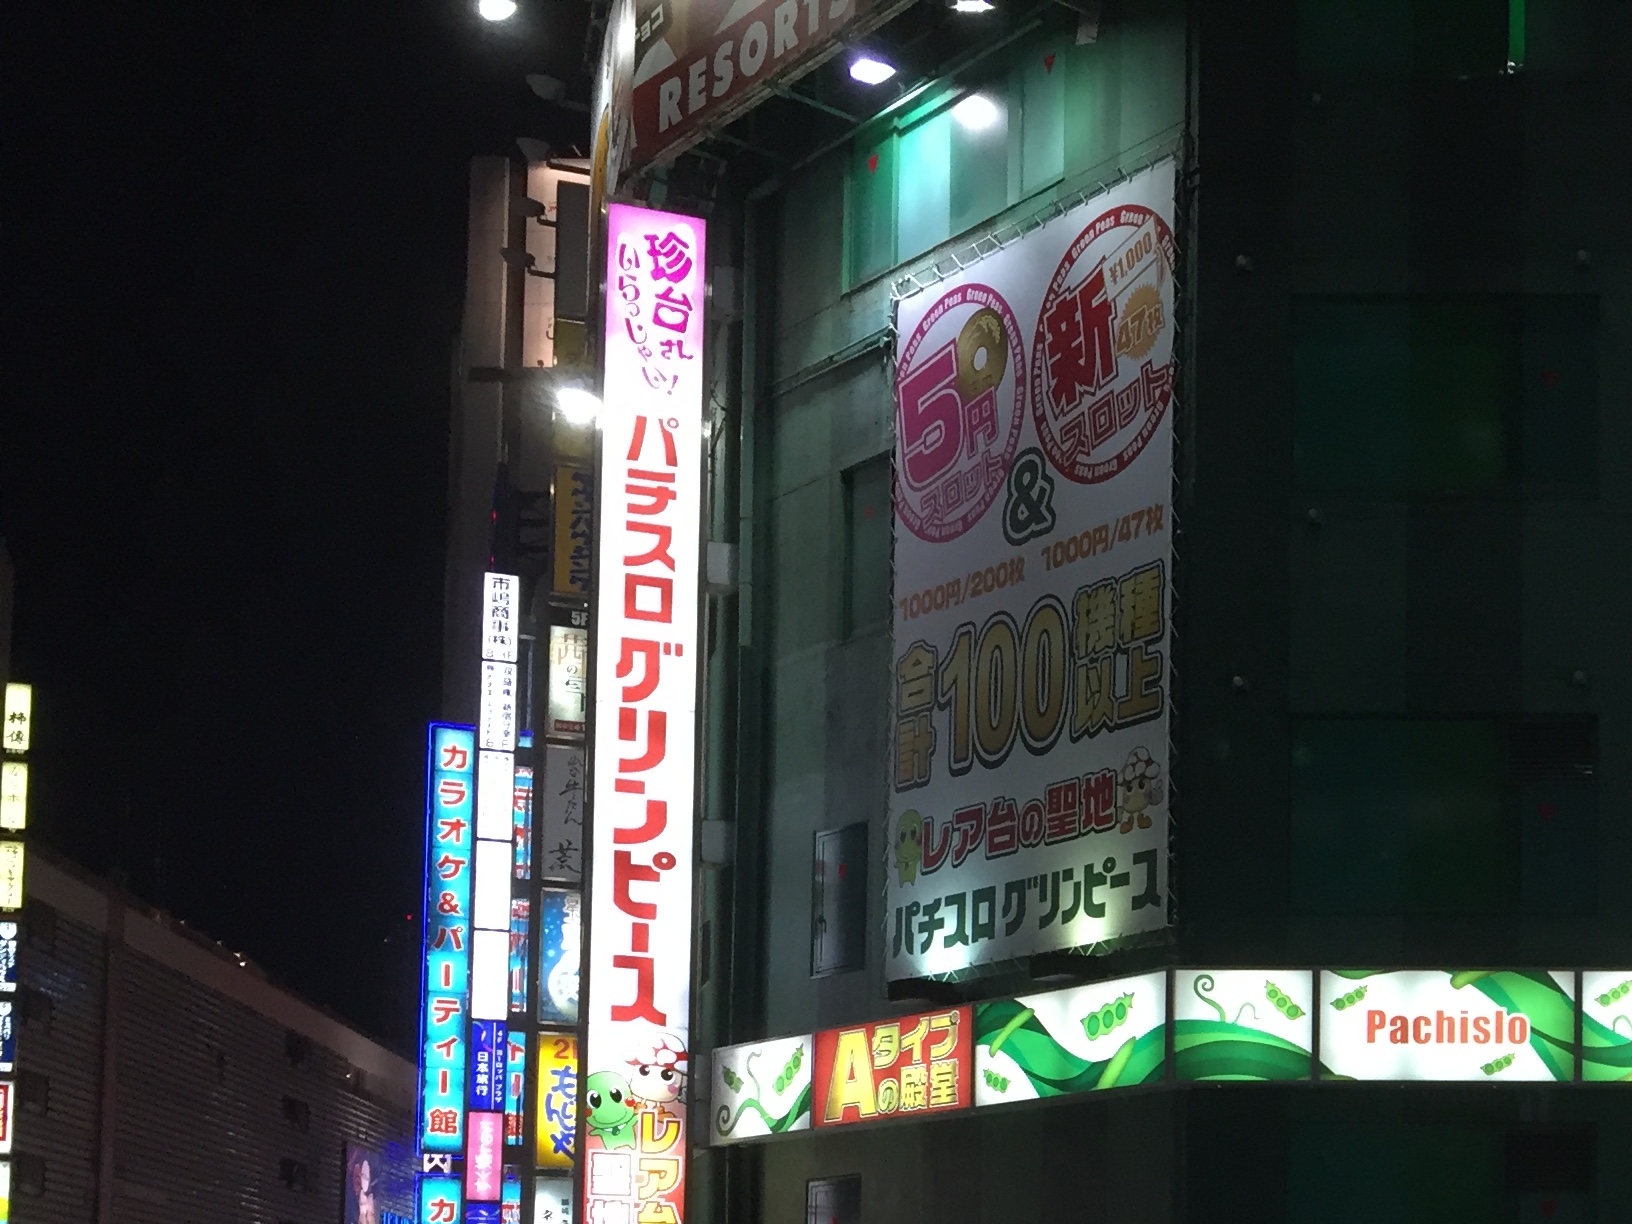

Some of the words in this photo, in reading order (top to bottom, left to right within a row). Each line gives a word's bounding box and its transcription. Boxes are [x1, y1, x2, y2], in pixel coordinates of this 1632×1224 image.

[644, 231, 694, 362] 珍台さん
[1045, 270, 1119, 421] 新
[1059, 363, 1173, 468] スロット
[1002, 447, 1056, 546] &
[611, 414, 684, 1027] パチスログリンピース
[938, 593, 1070, 777] 100
[920, 767, 1118, 876] レア台の聖地
[428, 743, 468, 1135] カラオケ&パーティー館
[892, 848, 1163, 960] パチスログリンピース
[475, 1051, 490, 1096] 日本旅行
[1365, 1008, 1529, 1046] Pachislo
